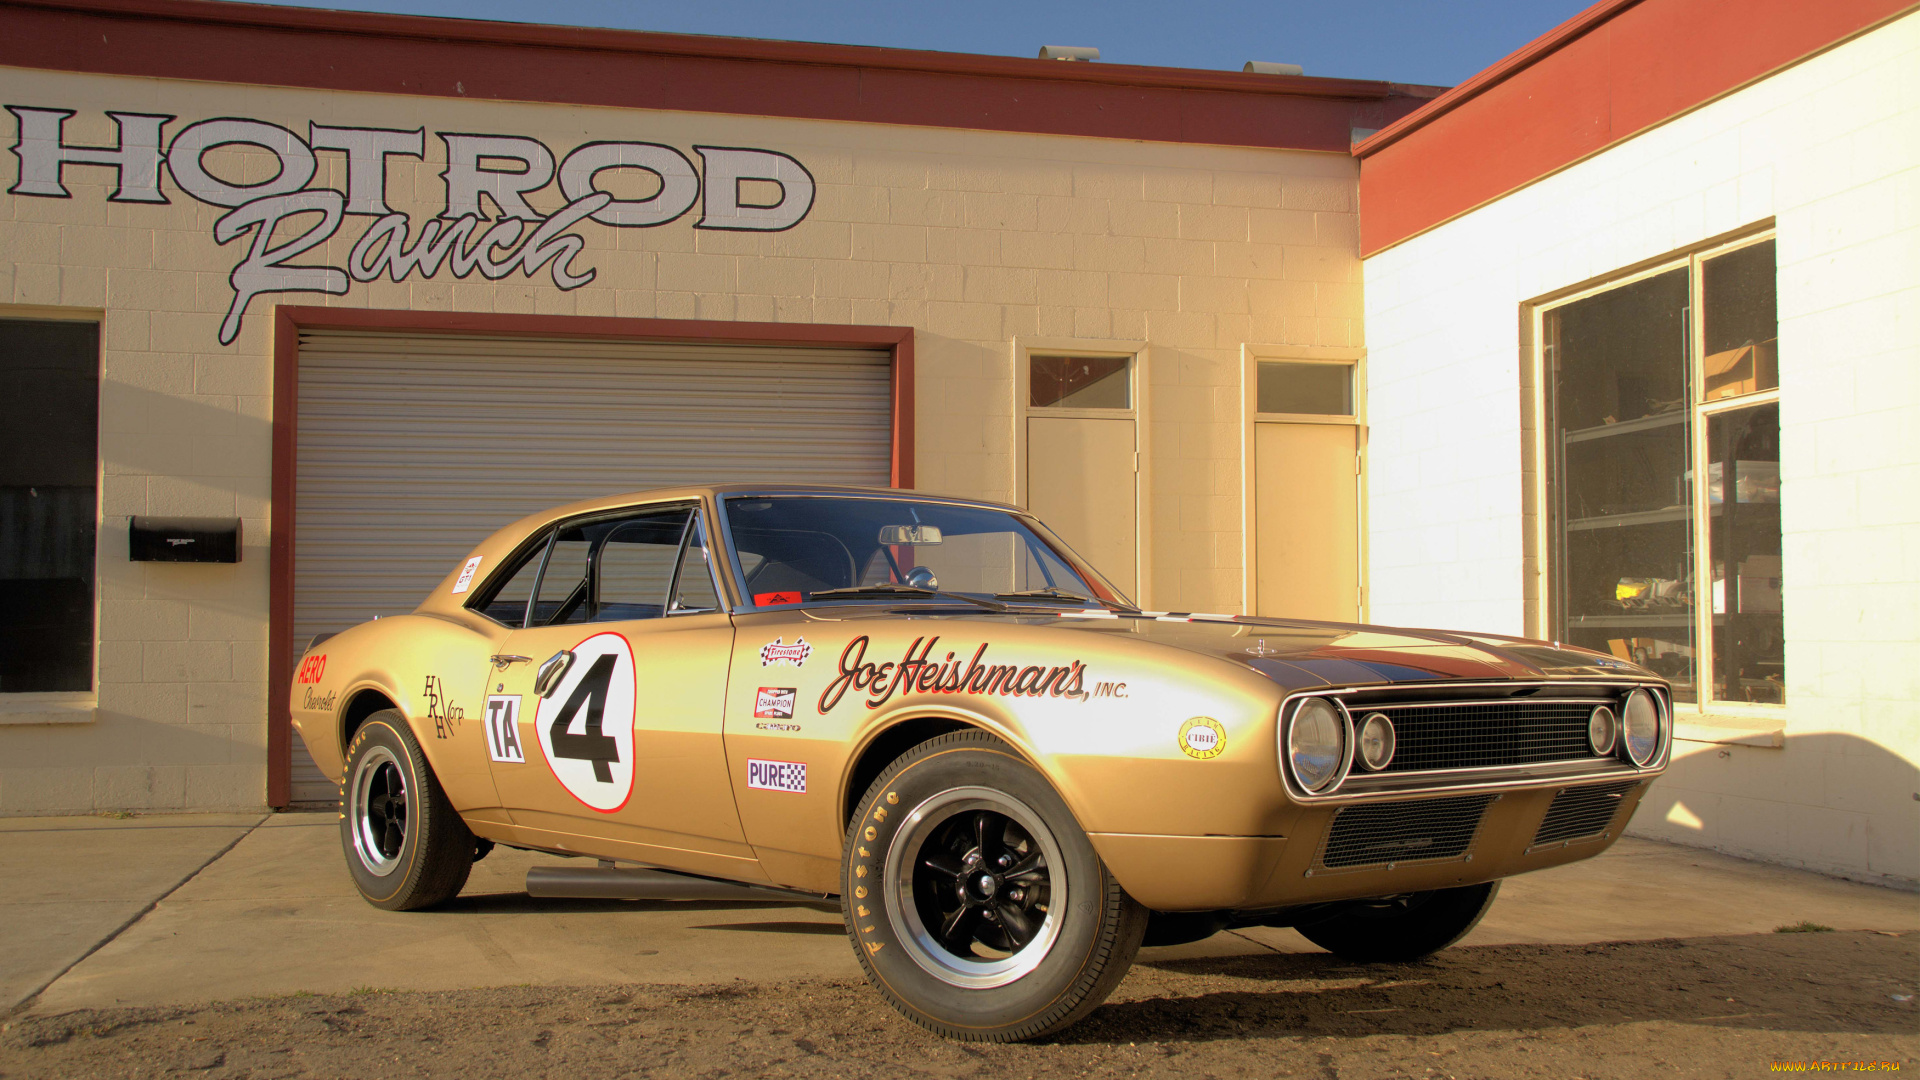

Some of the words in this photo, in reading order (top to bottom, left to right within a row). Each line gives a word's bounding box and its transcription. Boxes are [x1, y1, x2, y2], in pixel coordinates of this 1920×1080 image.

[216, 189, 597, 345] Ranch
[297, 653, 328, 685] AERO
[770, 647, 801, 656] Firestone
[865, 635, 1090, 710] Heishman's,
[1093, 681, 1130, 699] INC.
[303, 686, 337, 712] Chevrolet
[550, 653, 621, 784] 4
[758, 697, 792, 709] CHAMPION
[488, 700, 523, 759] TA
[750, 762, 786, 788] PURE
[854, 790, 901, 958] Firestone
